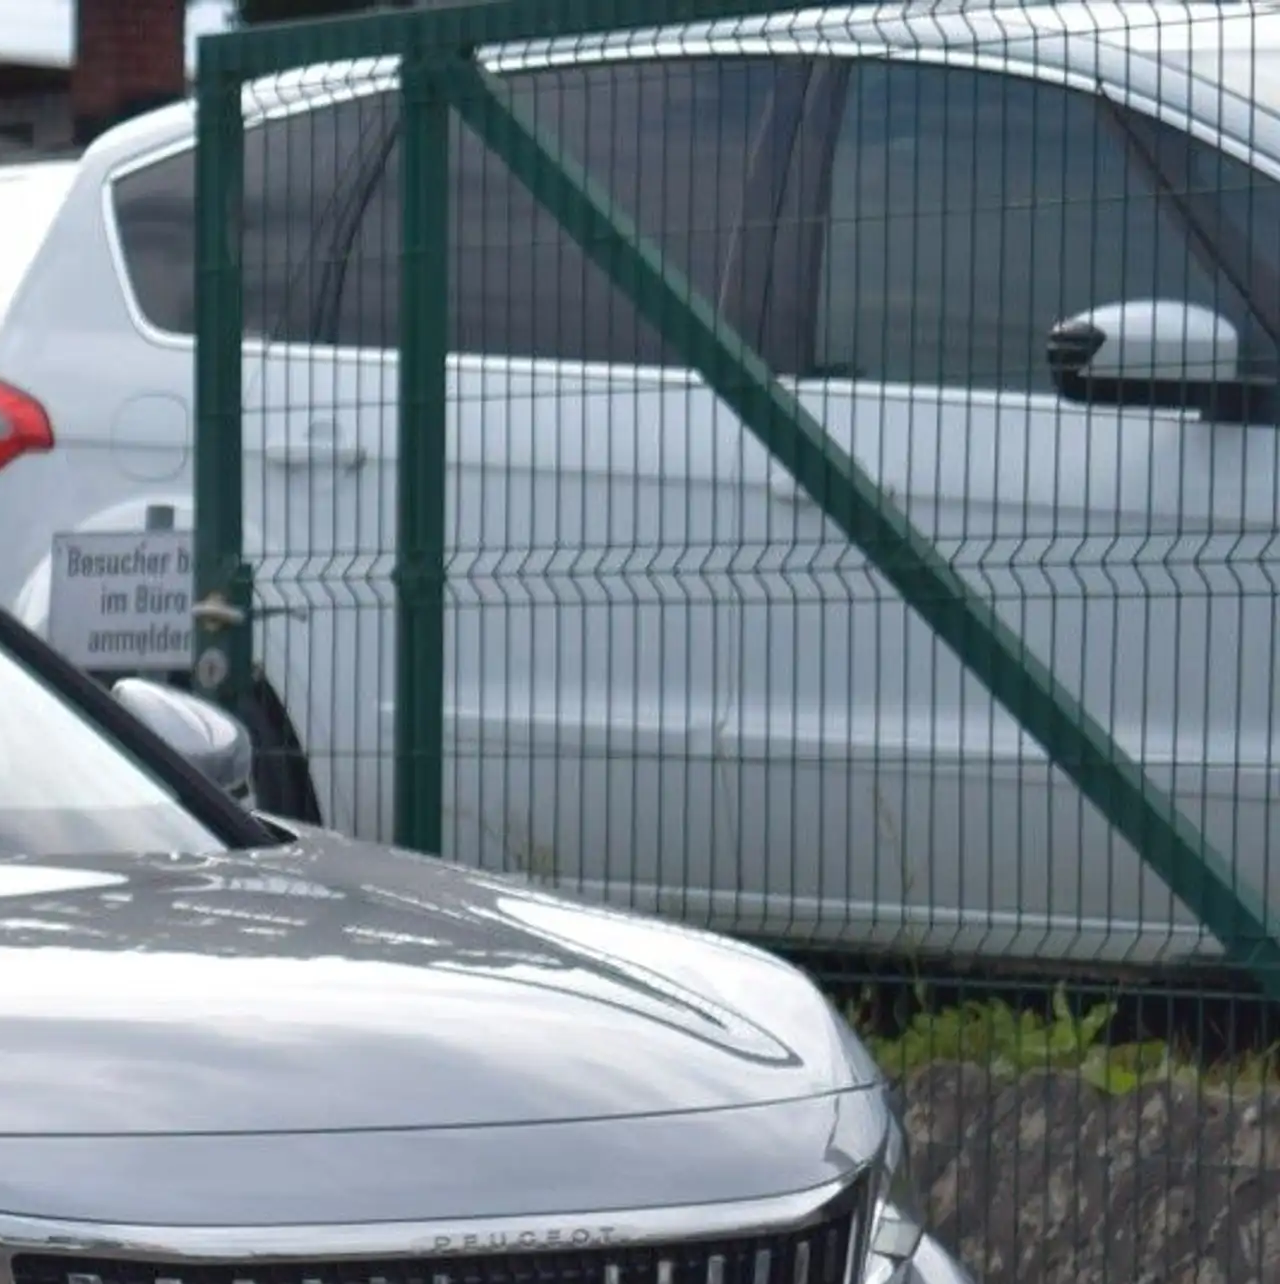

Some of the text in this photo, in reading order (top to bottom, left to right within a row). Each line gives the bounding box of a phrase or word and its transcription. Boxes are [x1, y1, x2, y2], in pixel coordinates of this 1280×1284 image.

[66, 542, 171, 577] Besucher
[100, 580, 188, 617] im Büro
[432, 1225, 615, 1252] PEUGEOT
